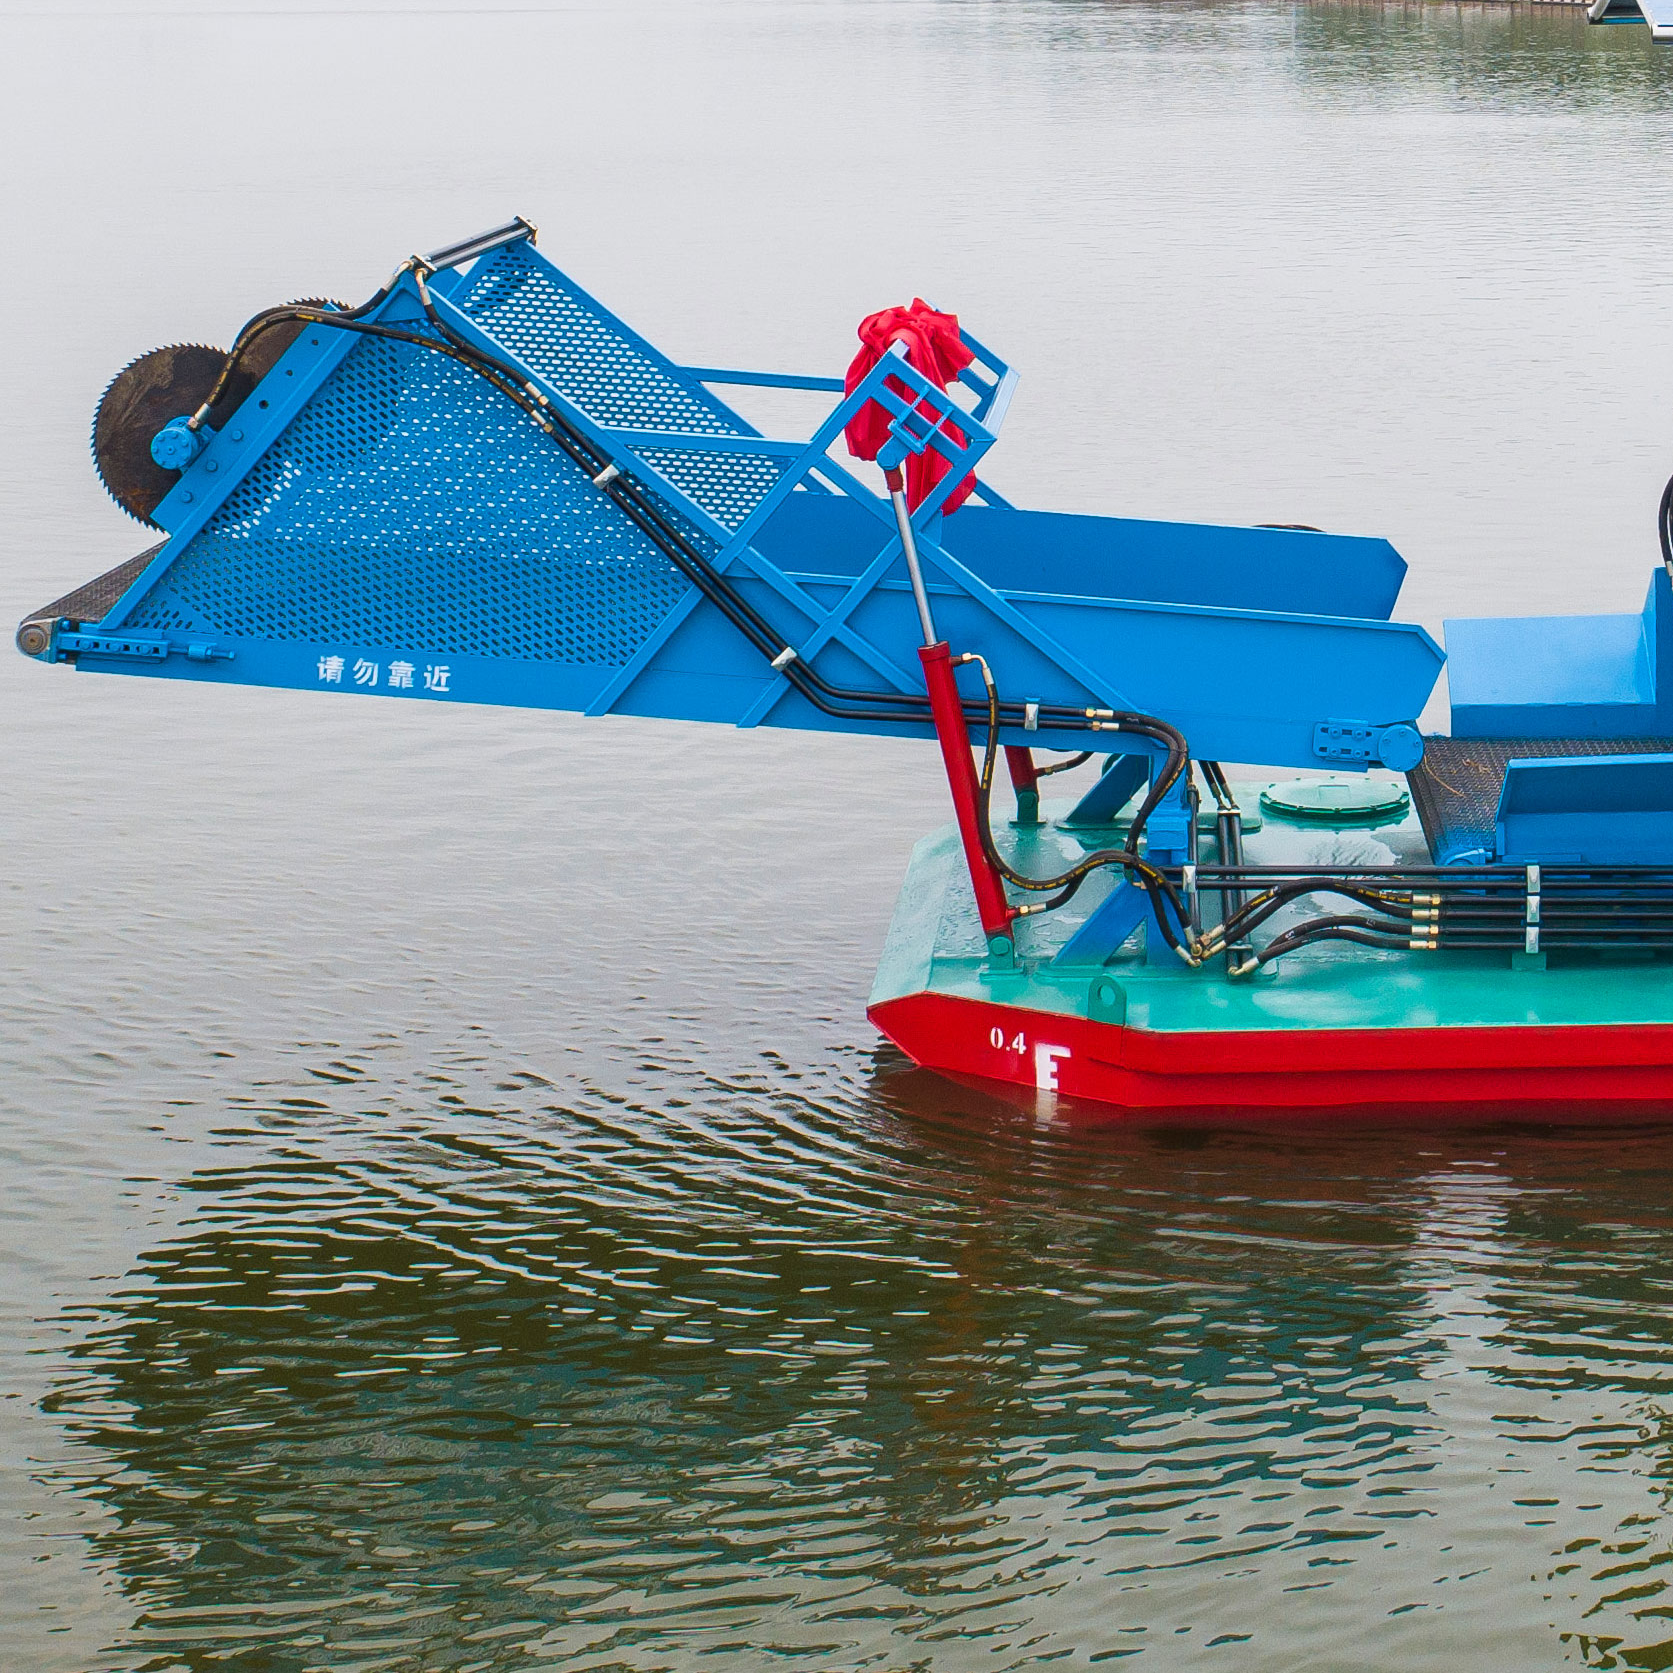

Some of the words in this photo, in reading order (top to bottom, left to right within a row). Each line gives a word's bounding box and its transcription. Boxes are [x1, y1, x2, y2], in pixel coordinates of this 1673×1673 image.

[316, 655, 452, 692] 请勿靠近
[989, 1026, 1027, 1055] 0.4
